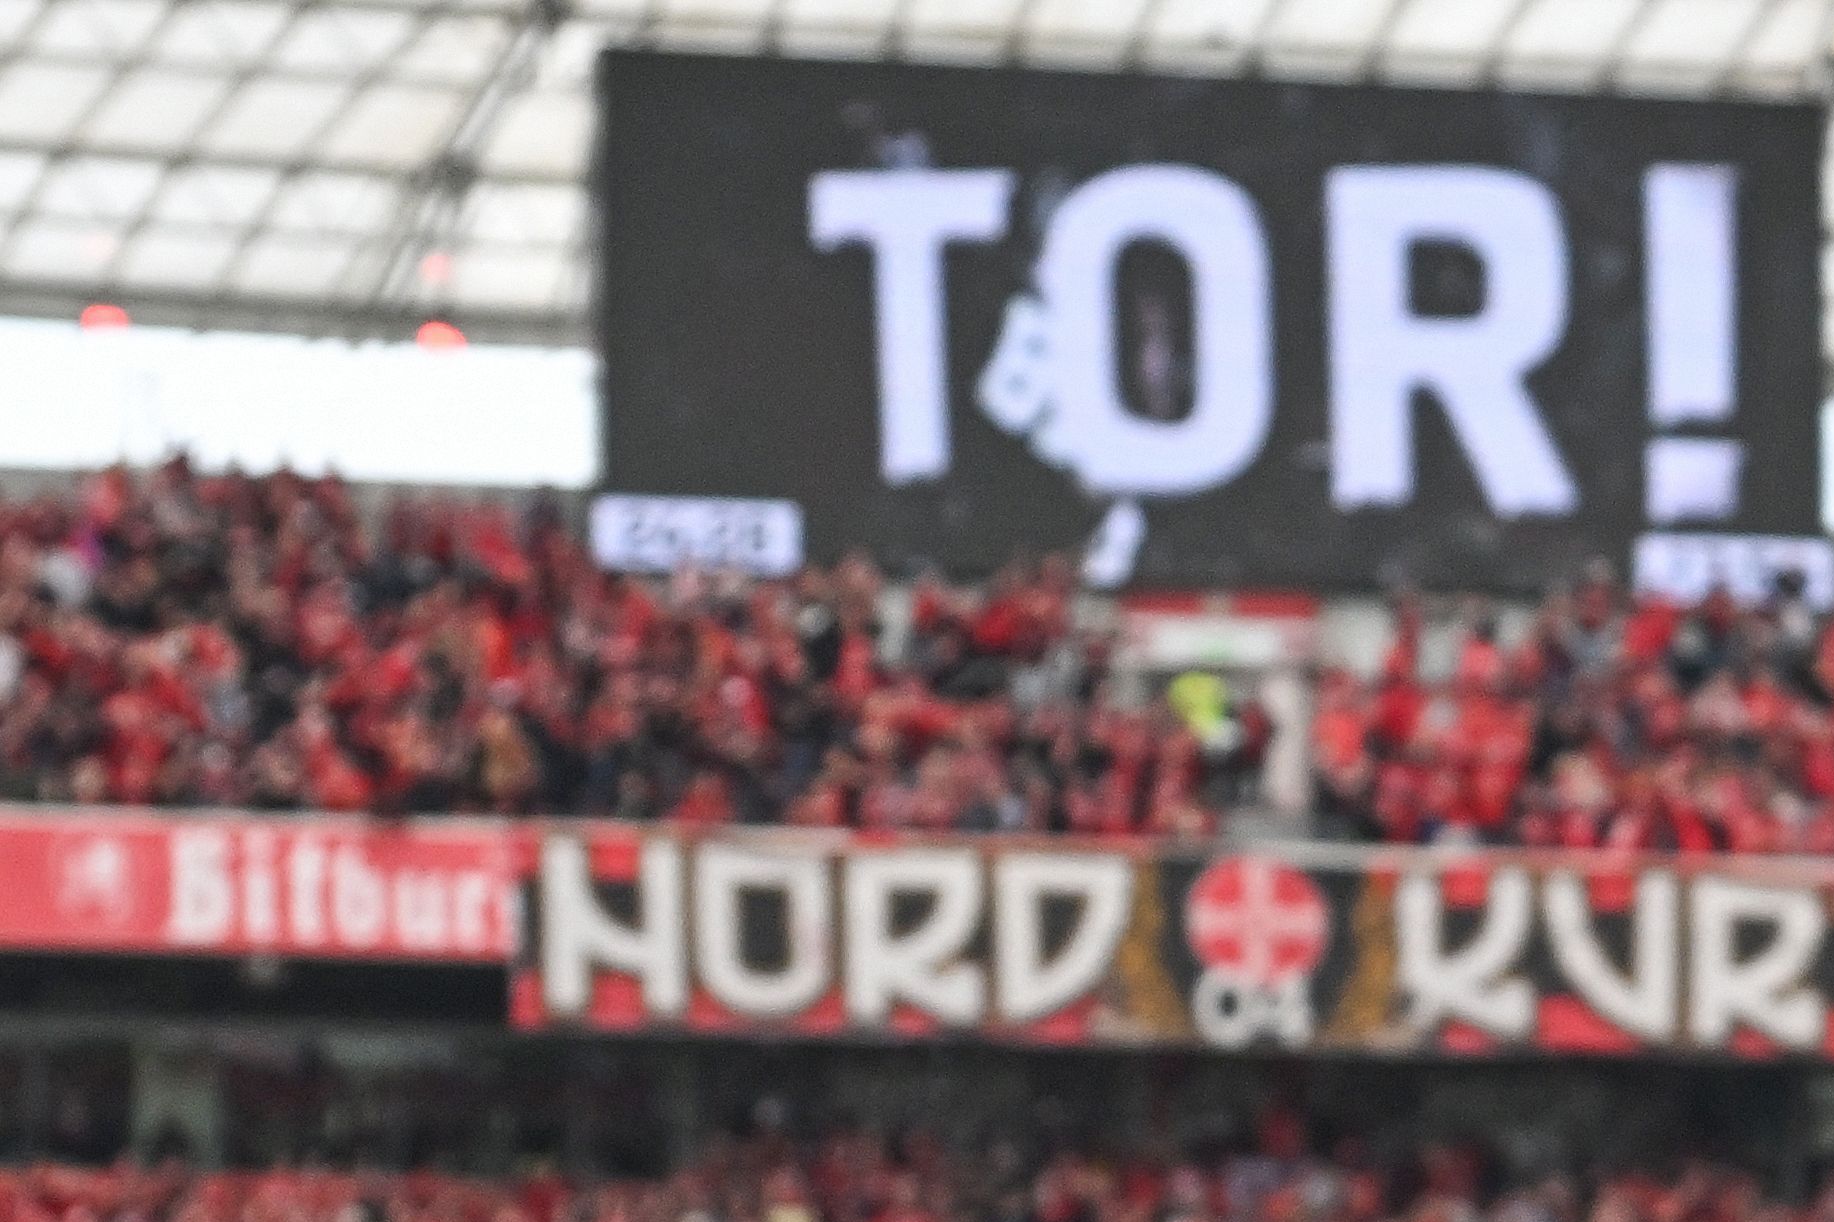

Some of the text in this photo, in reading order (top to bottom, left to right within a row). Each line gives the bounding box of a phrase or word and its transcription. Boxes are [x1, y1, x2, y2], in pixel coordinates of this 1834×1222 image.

[808, 160, 1744, 526] TOR!
[168, 825, 518, 954] Bitbur
[538, 832, 1136, 1028] NORD
